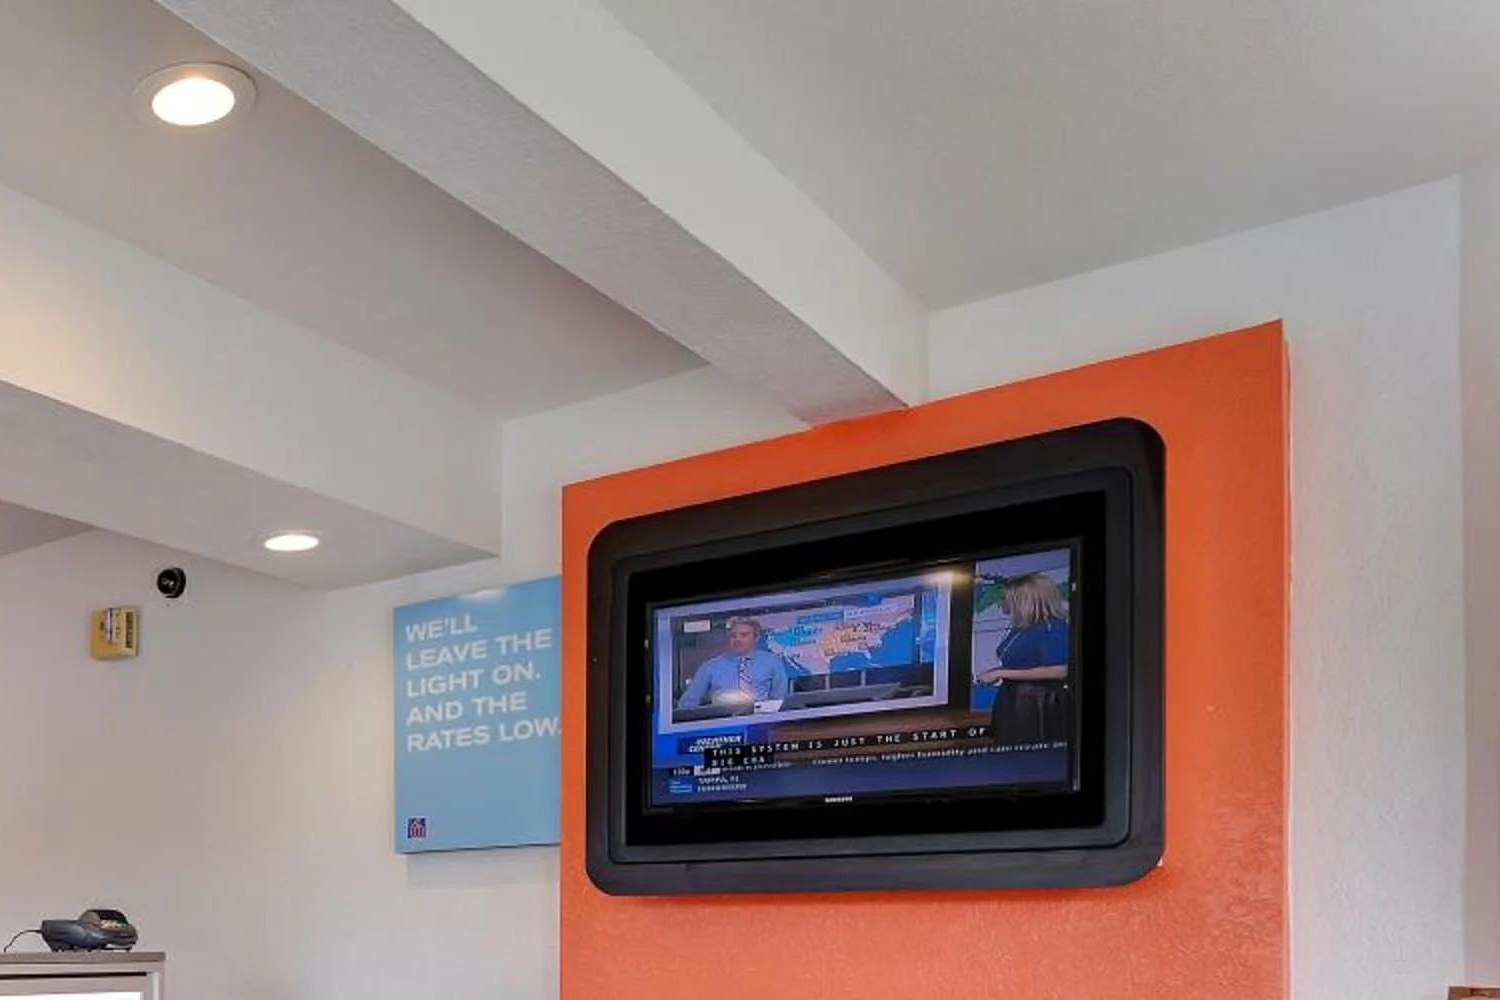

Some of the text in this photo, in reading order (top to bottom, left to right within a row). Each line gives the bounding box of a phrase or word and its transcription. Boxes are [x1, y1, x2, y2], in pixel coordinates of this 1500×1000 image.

[405, 613, 478, 642] WE'LL
[406, 628, 552, 671] LEAVE THE
[407, 661, 541, 698] LIGHT ON.
[406, 691, 527, 726] AND THE
[407, 725, 491, 752] RATES
[808, 741, 822, 749] IS
[833, 737, 865, 747] JUST
[876, 734, 901, 743] THE
[912, 730, 957, 741] START
[969, 727, 987, 737] OF
